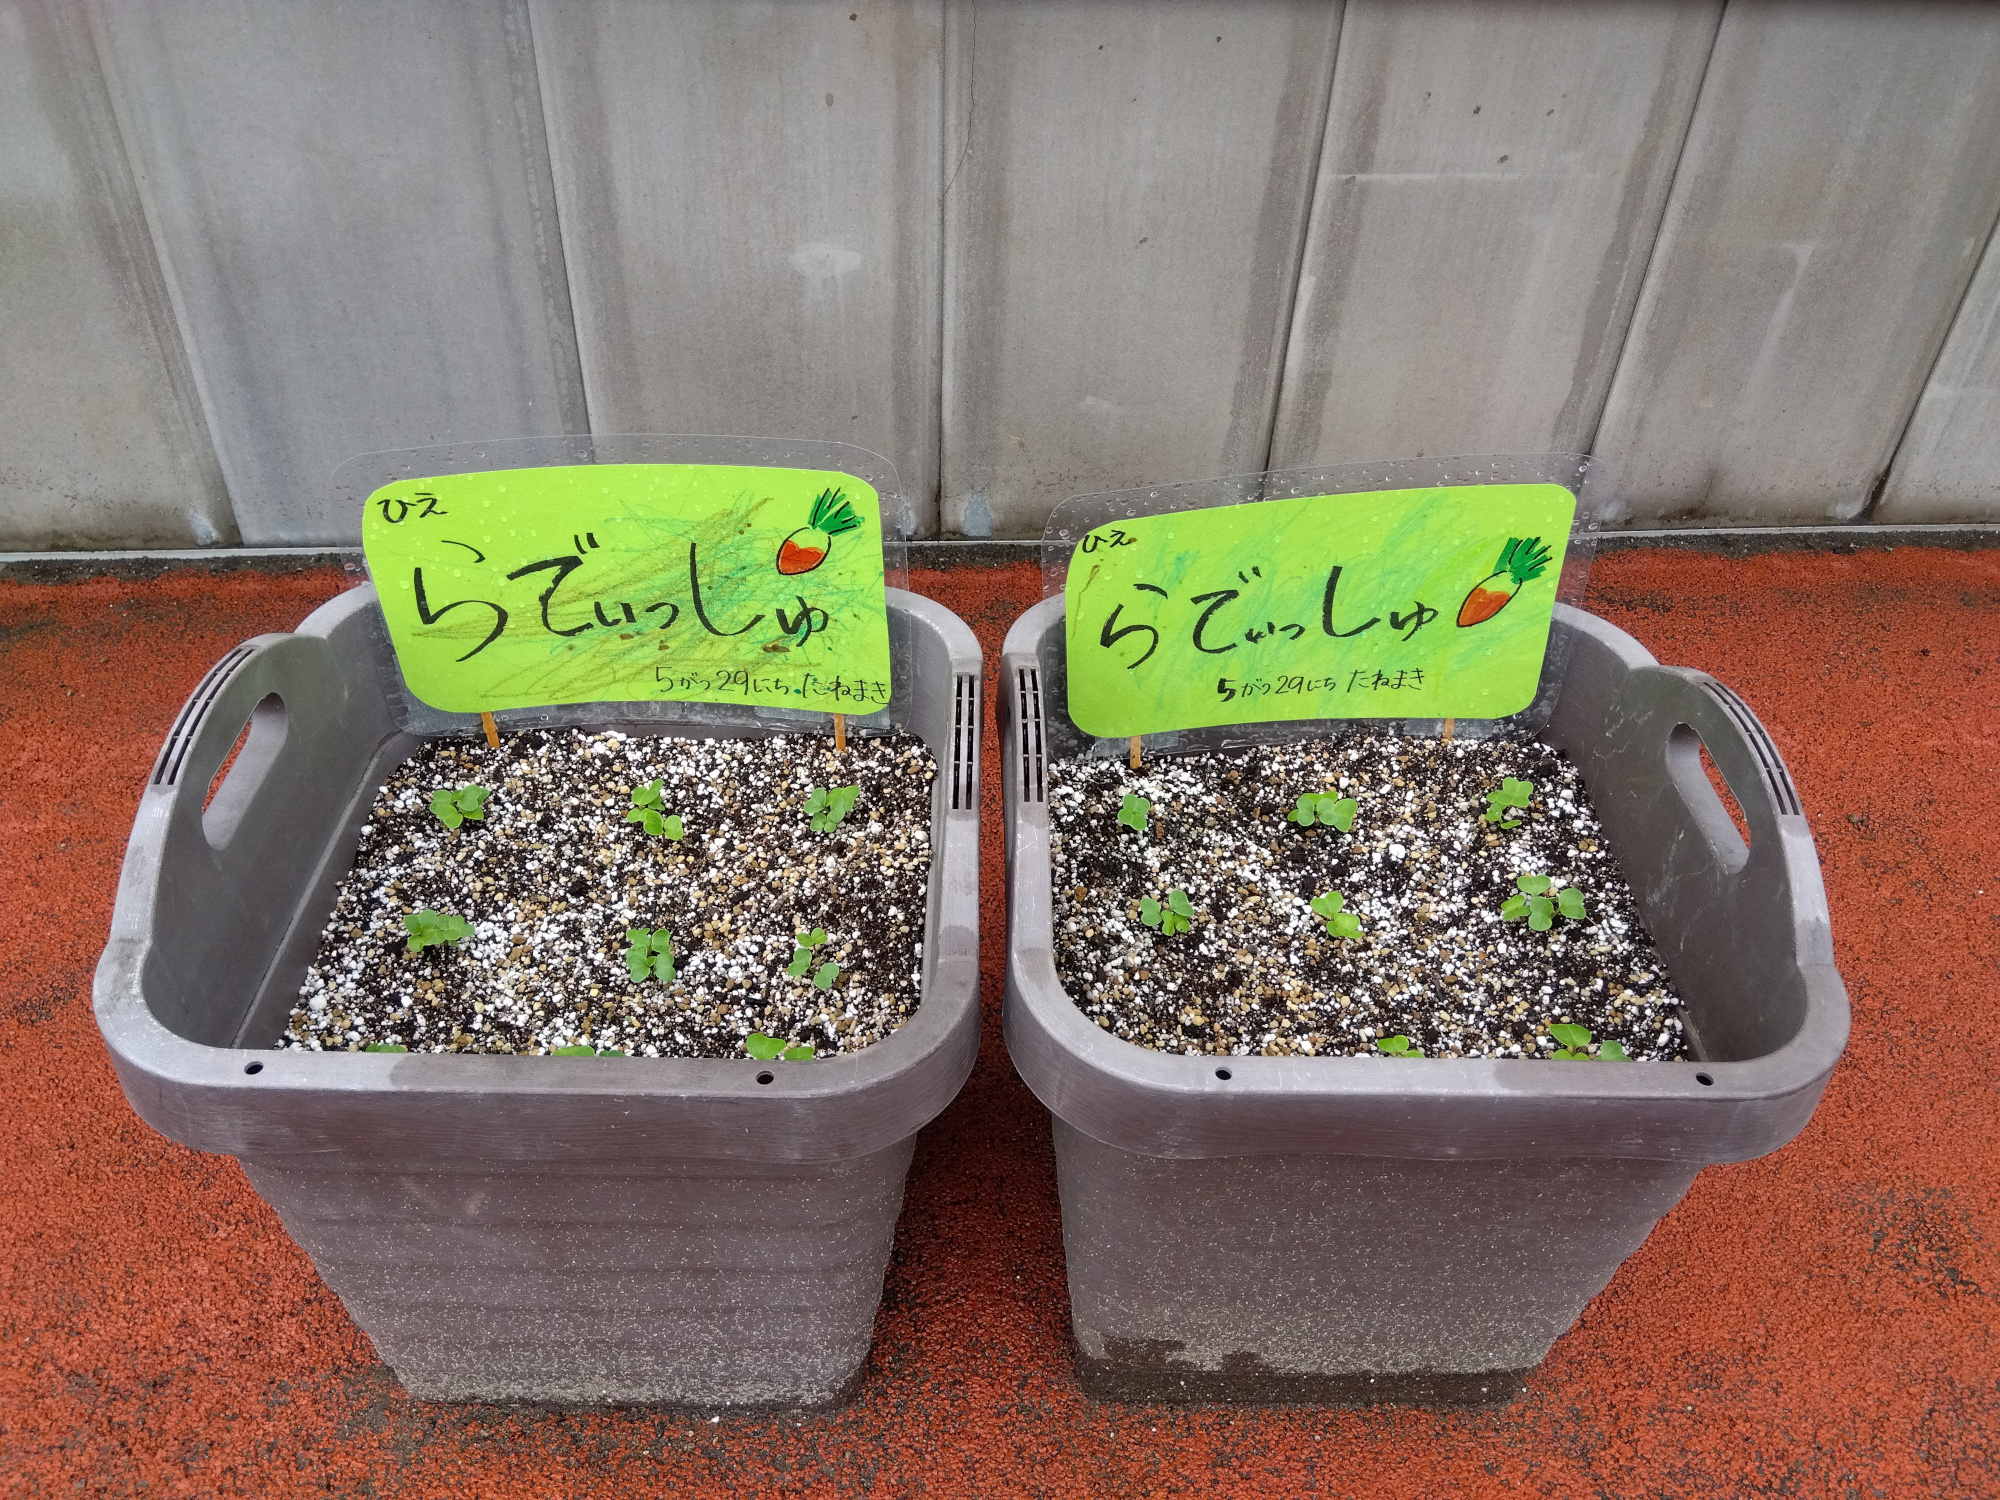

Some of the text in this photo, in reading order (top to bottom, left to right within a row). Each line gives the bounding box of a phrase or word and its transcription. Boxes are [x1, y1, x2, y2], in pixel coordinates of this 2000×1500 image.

[377, 494, 448, 523] ひえ
[1081, 530, 1136, 553] ひえ
[802, 672, 889, 704] たねまき
[1346, 667, 1425, 693] たねまき
